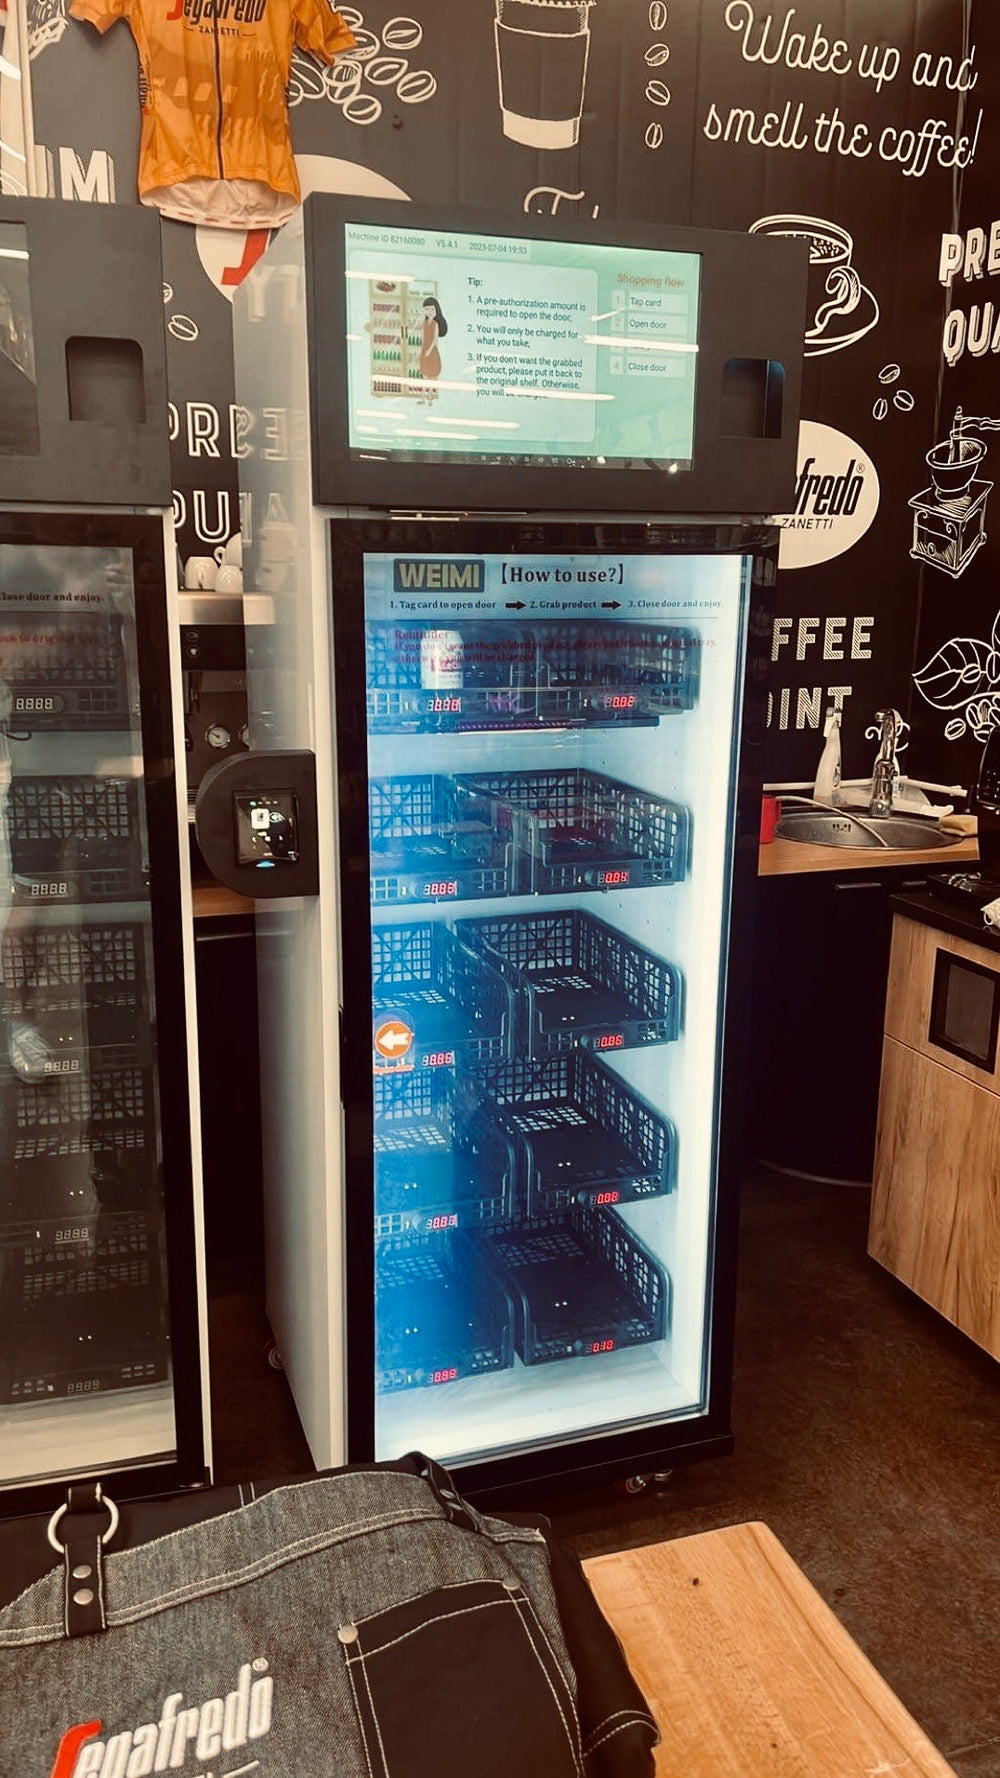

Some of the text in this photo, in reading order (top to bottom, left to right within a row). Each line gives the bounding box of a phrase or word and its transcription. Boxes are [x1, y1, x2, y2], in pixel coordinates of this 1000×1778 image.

[724, 0, 978, 93] Wake up and
[703, 101, 983, 177] smell the coffee!
[349, 232, 380, 242] Machine
[468, 277, 483, 287] Tip:
[616, 274, 685, 288] Shopping flow
[484, 297, 548, 308] pre-authorization
[550, 302, 578, 311] amount
[579, 303, 586, 311] is
[630, 297, 643, 306] Tap
[645, 299, 662, 307] card
[476, 308, 508, 318] required
[509, 310, 517, 318] to
[519, 311, 538, 321] open
[539, 311, 551, 320] the
[629, 319, 649, 328] Open
[650, 321, 667, 329] door
[476, 325, 491, 333] You
[493, 326, 506, 334] will
[508, 327, 524, 337] only
[525, 328, 534, 336] be
[536, 329, 566, 340] charged
[568, 330, 578, 339] for
[942, 302, 1000, 367] QU
[476, 336, 495, 344] what
[497, 339, 511, 347] you
[483, 356, 498, 364] you
[520, 357, 538, 365] want
[539, 357, 551, 365] the
[552, 358, 583, 368] grabbed
[628, 362, 649, 371] Close
[650, 364, 667, 372] door
[508, 367, 533, 376] please
[535, 369, 547, 377] put
[549, 368, 554, 377] it
[555, 369, 573, 378] back
[574, 370, 582, 378] to
[476, 376, 488, 384] the
[490, 377, 518, 387] original
[476, 388, 490, 398] you
[492, 388, 504, 396] will
[780, 518, 834, 530] ZANETTI
[398, 563, 480, 588] WEIMI
[555, 567, 572, 583] to
[54, 592, 72, 602] and
[400, 600, 416, 610] Tag
[417, 600, 438, 609] card
[440, 601, 450, 609] to
[450, 602, 474, 610] open
[475, 600, 497, 609] door
[539, 600, 561, 609] Grab
[562, 600, 597, 610] product
[628, 600, 636, 608] 3.
[637, 600, 659, 608] Close
[661, 599, 680, 607] door
[682, 599, 697, 607] and
[770, 616, 875, 661] FFEE
[766, 686, 853, 730] INT
